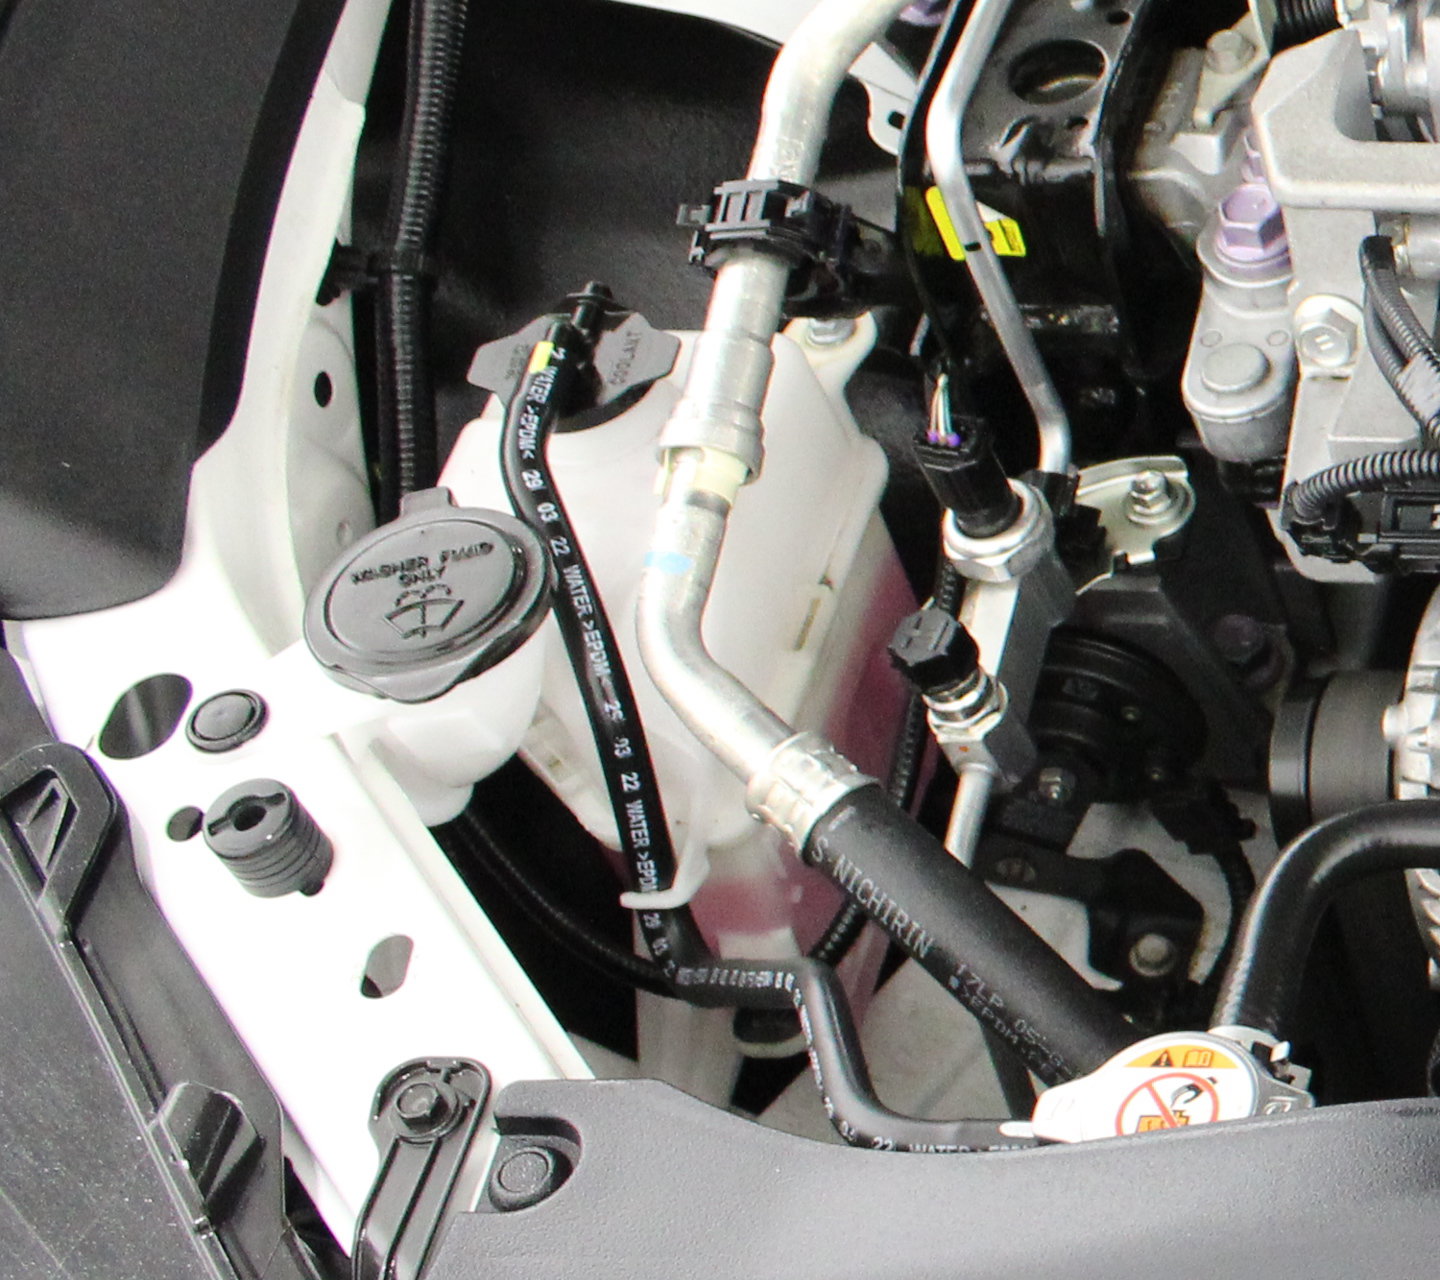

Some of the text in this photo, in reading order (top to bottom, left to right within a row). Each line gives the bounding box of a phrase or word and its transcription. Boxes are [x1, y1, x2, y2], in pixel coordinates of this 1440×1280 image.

[550, 535, 572, 557] 22
[563, 564, 594, 622] WATER
[619, 770, 641, 793] 22
[627, 798, 652, 851] WATER
